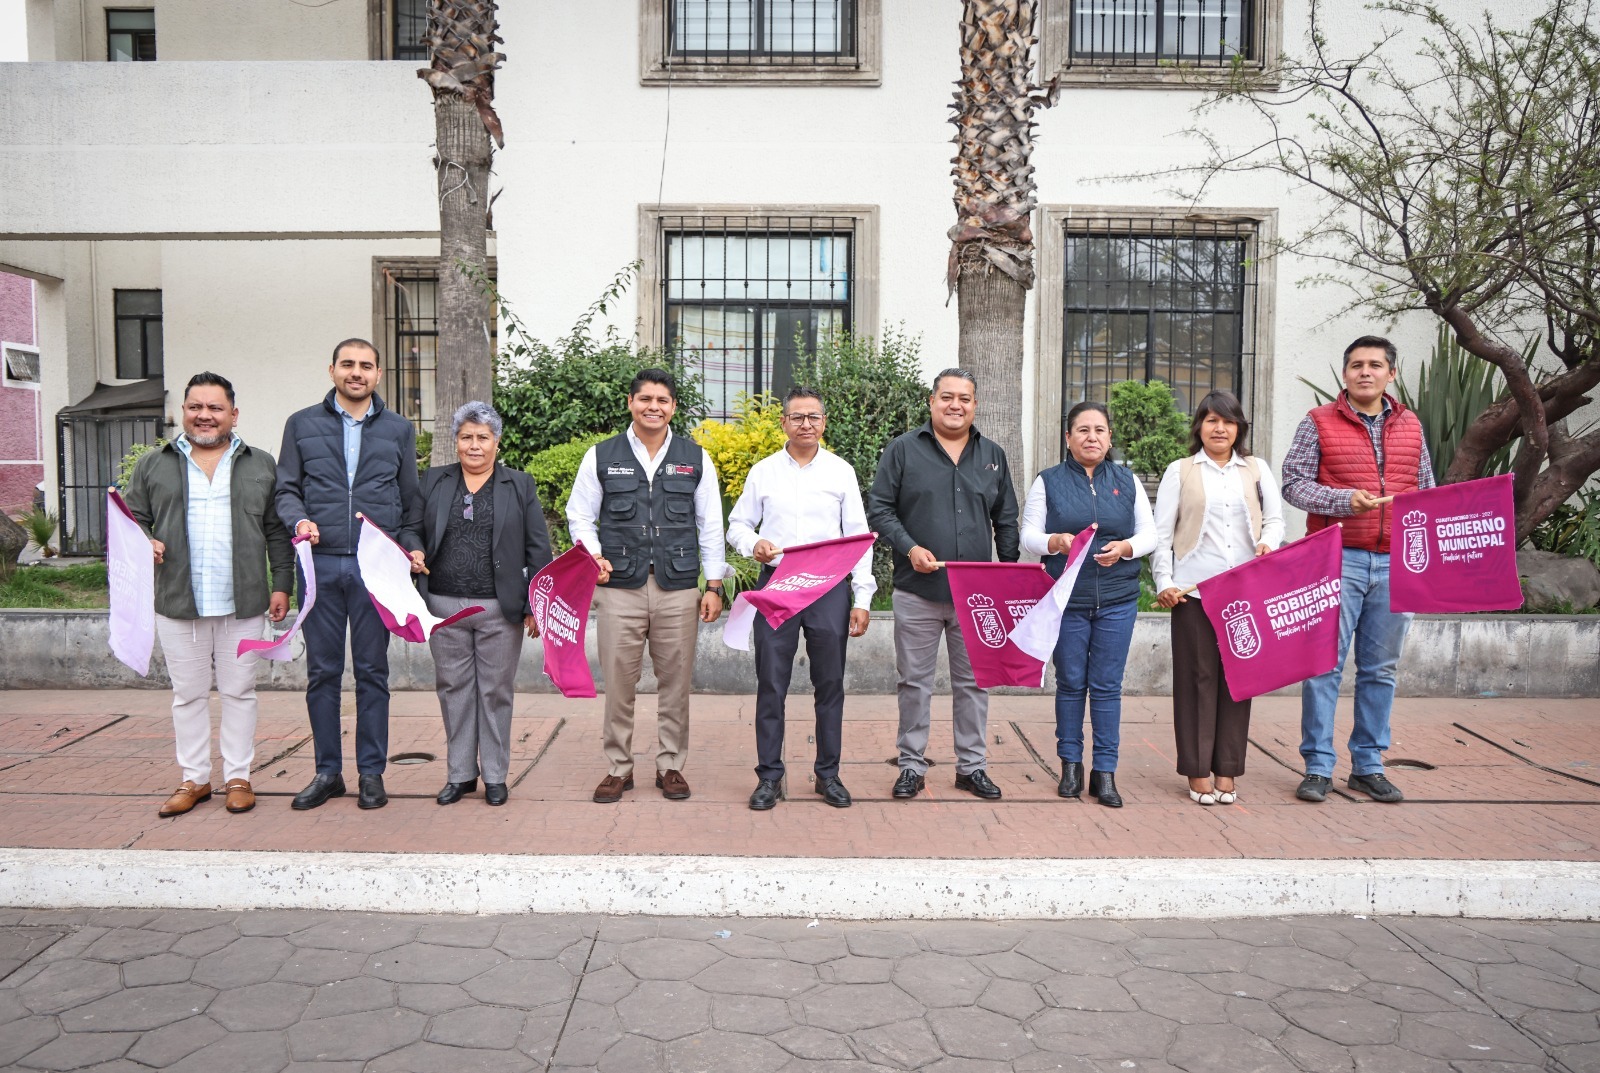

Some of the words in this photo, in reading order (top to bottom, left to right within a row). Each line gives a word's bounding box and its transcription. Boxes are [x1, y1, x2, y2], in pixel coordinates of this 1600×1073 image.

[1436, 517, 1505, 538] GOBIERNO
[1438, 533, 1504, 552] MUNICIPAL
[1266, 579, 1340, 618] GOBIERNO
